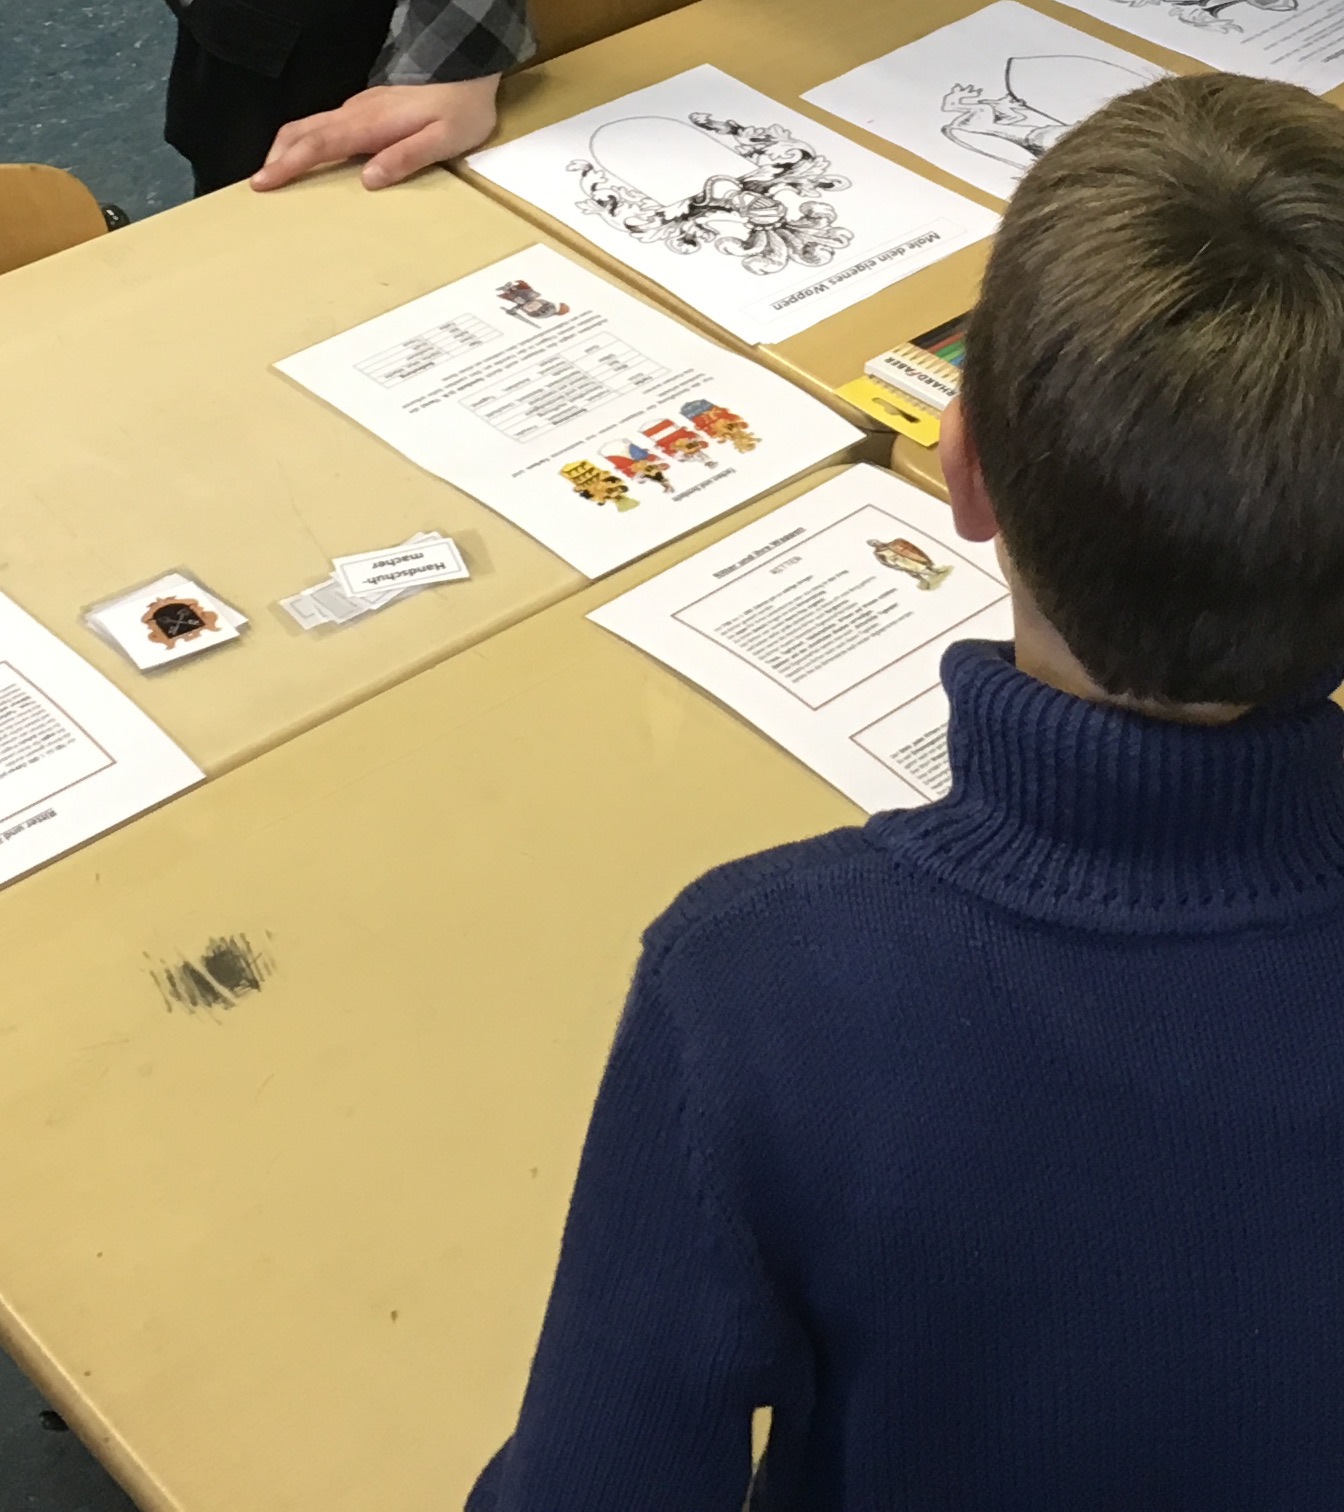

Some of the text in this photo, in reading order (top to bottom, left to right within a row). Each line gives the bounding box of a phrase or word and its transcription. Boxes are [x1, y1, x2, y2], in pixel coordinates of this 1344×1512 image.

[771, 232, 940, 312] Male dein eigenes Wappen
[371, 552, 424, 569] macher
[361, 561, 446, 586] Handschuh-
[26, 808, 57, 828] Ritter
[3, 823, 24, 840] und
